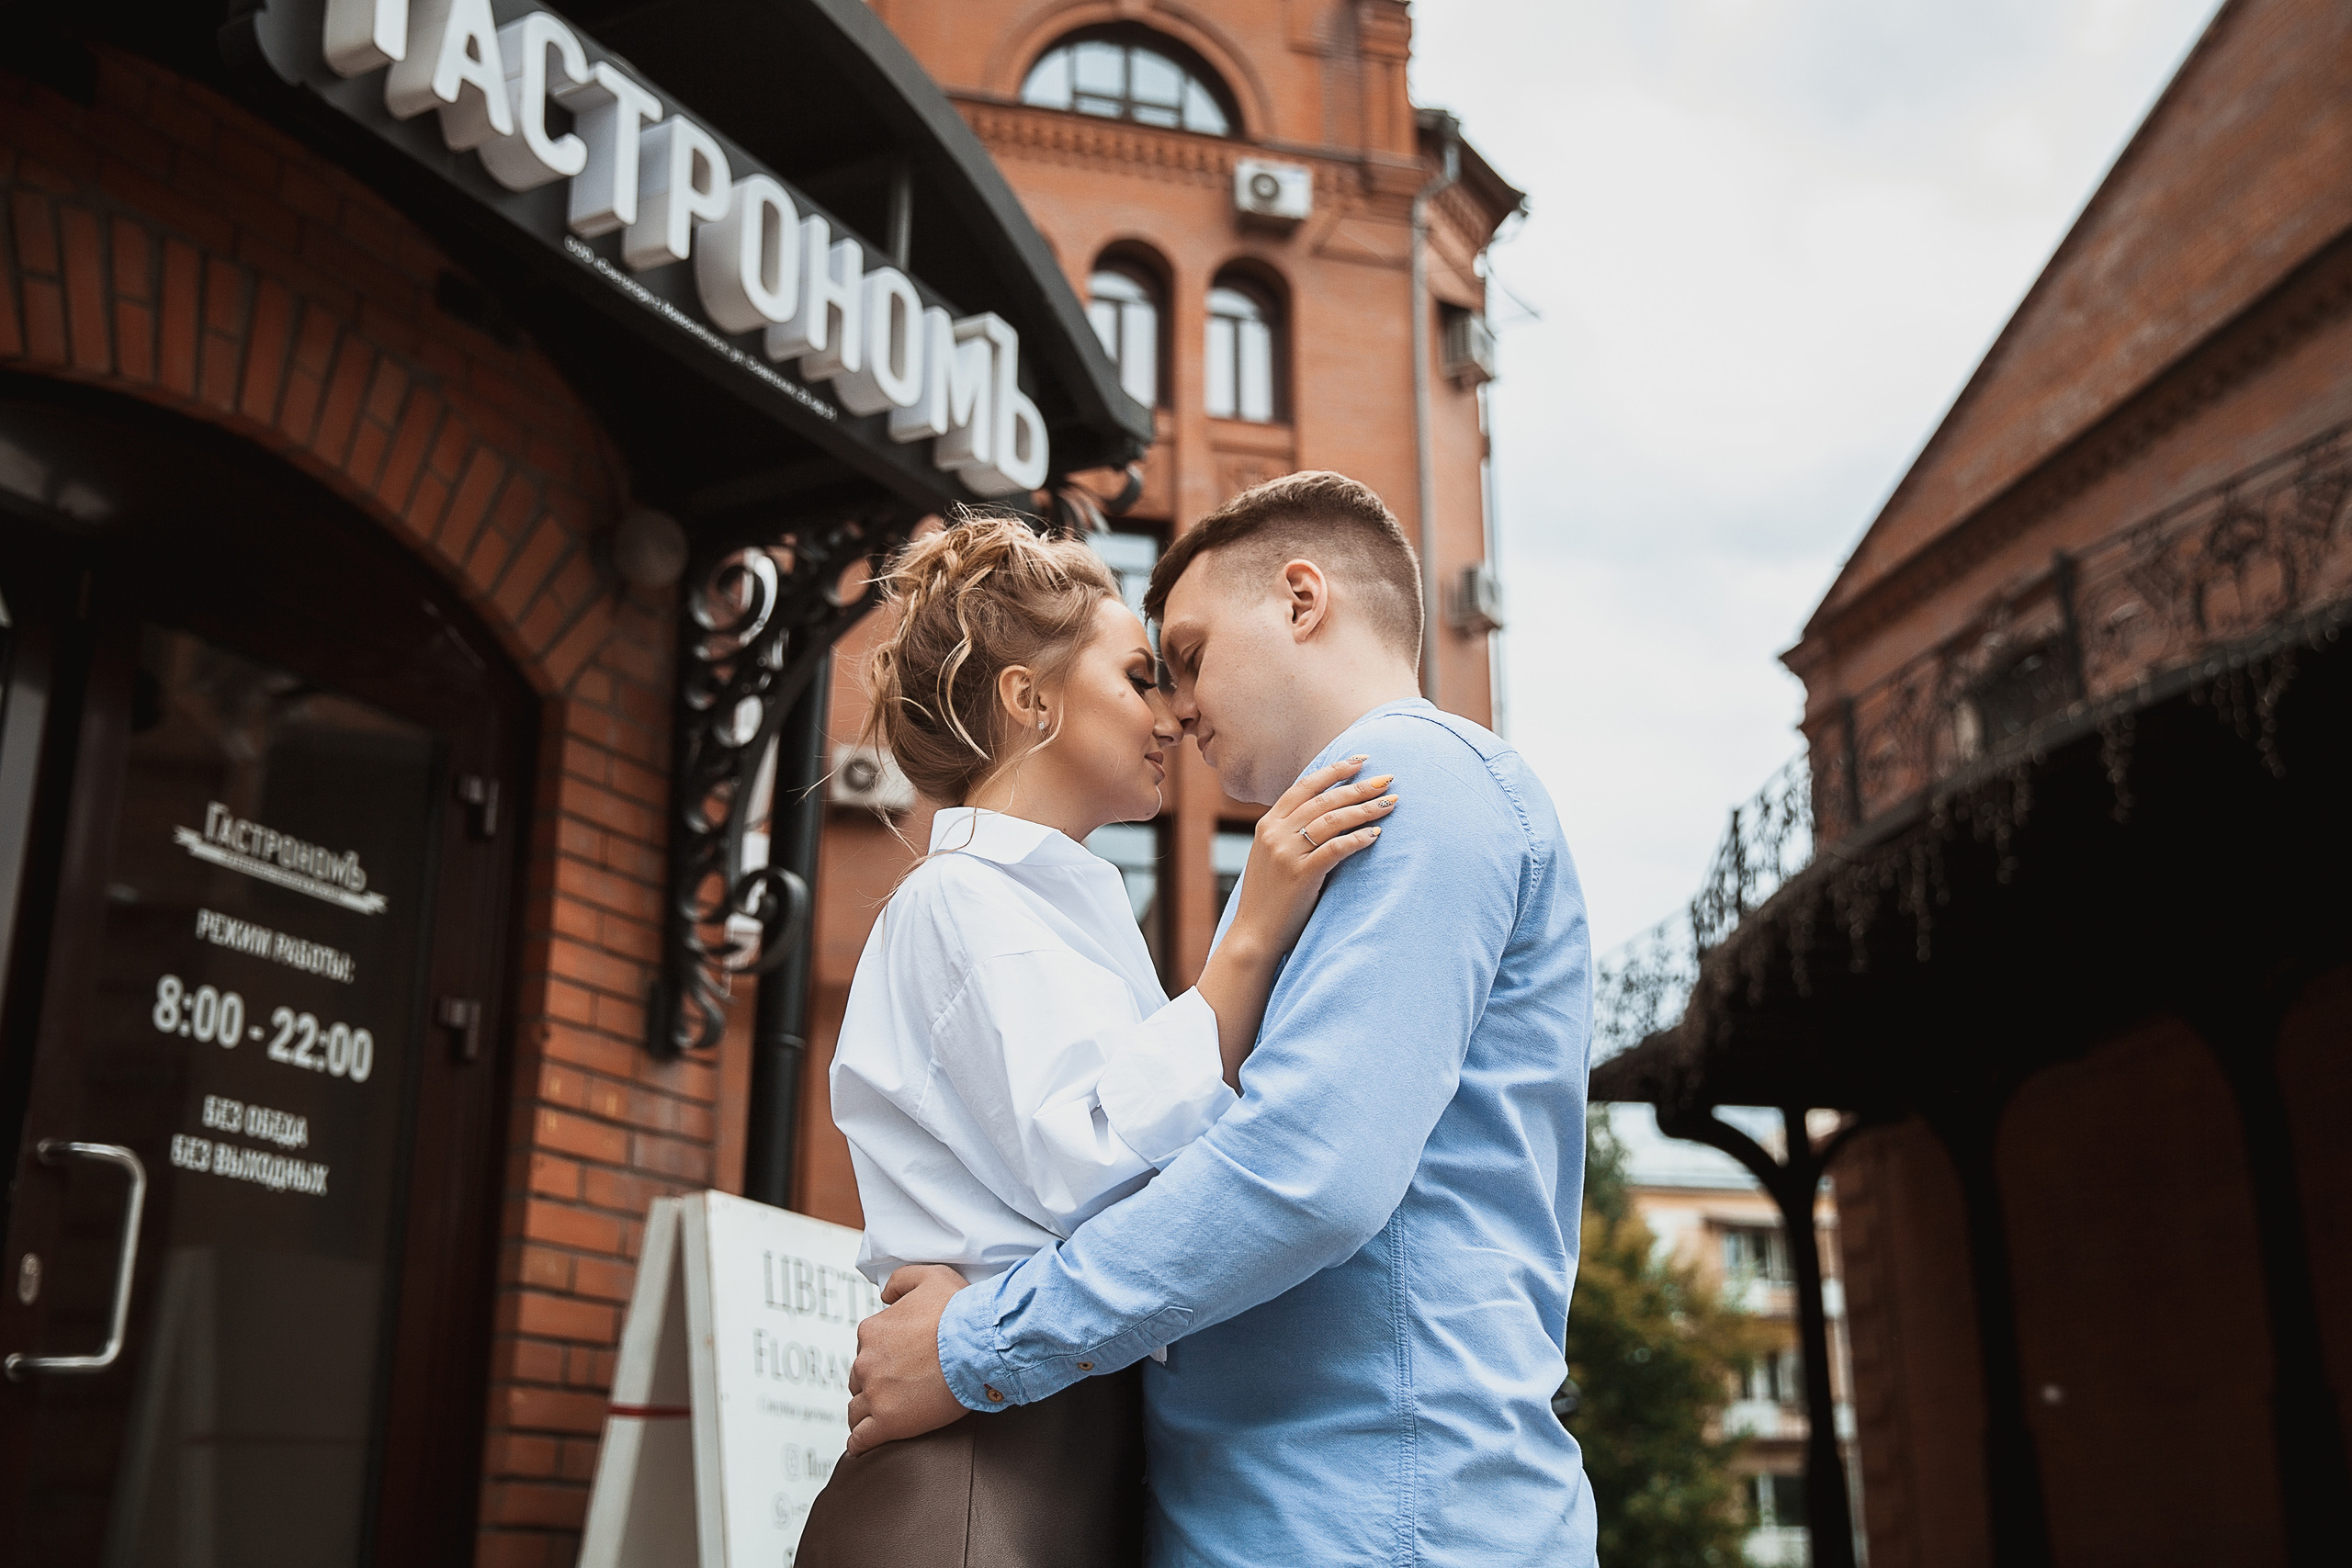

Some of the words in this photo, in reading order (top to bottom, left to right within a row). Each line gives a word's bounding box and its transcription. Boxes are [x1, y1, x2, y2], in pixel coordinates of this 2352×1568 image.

[196, 908, 270, 958] РЕЖИМ
[273, 932, 356, 984] РАБОТЫ:
[153, 974, 244, 1048] 8:00
[267, 1006, 374, 1082] 22:00
[202, 1095, 243, 1134] БЕЗ
[244, 1105, 309, 1149] ОБЕДА
[170, 1134, 211, 1172] БЕЗ
[212, 1142, 330, 1195] ВЫХОДНЫХ
